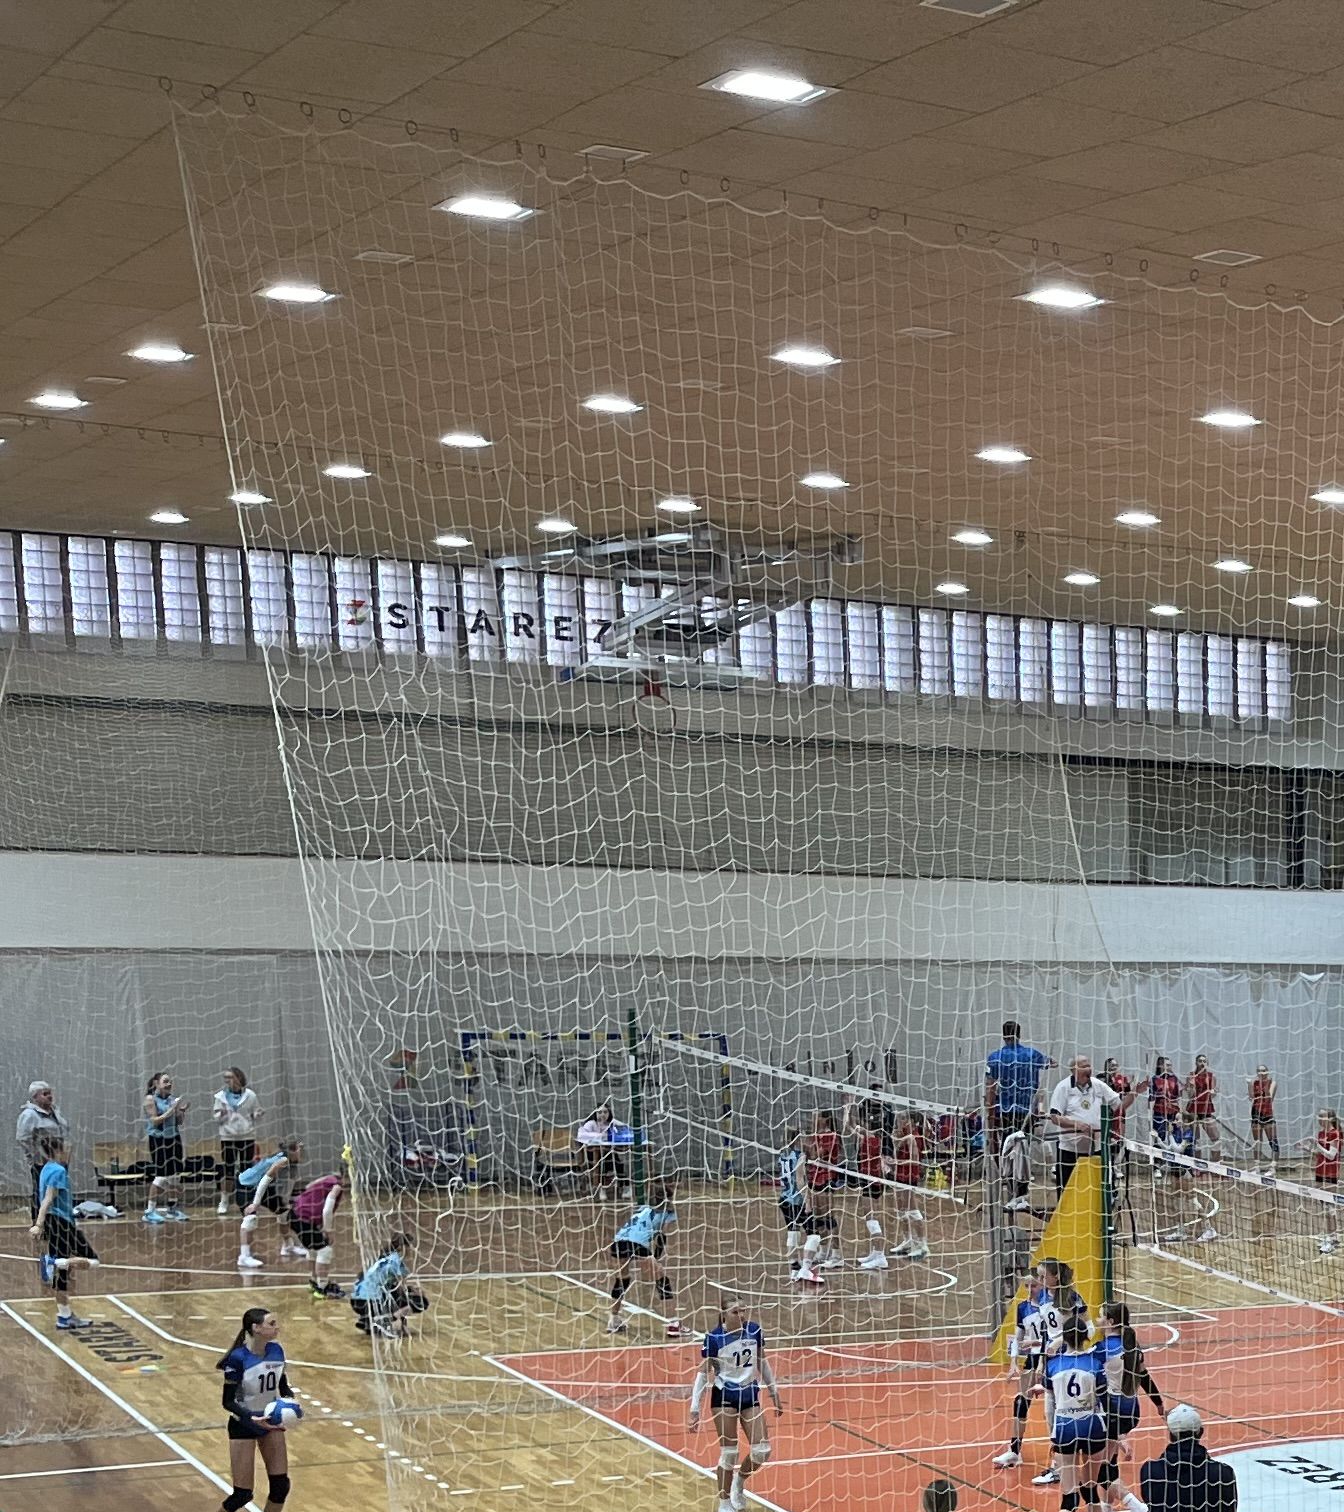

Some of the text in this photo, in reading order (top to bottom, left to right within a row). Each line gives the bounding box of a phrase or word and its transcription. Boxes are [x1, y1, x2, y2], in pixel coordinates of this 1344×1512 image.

[733, 1348, 753, 1368] 12
[257, 1371, 277, 1394] 10
[1066, 1373, 1081, 1398] 6
